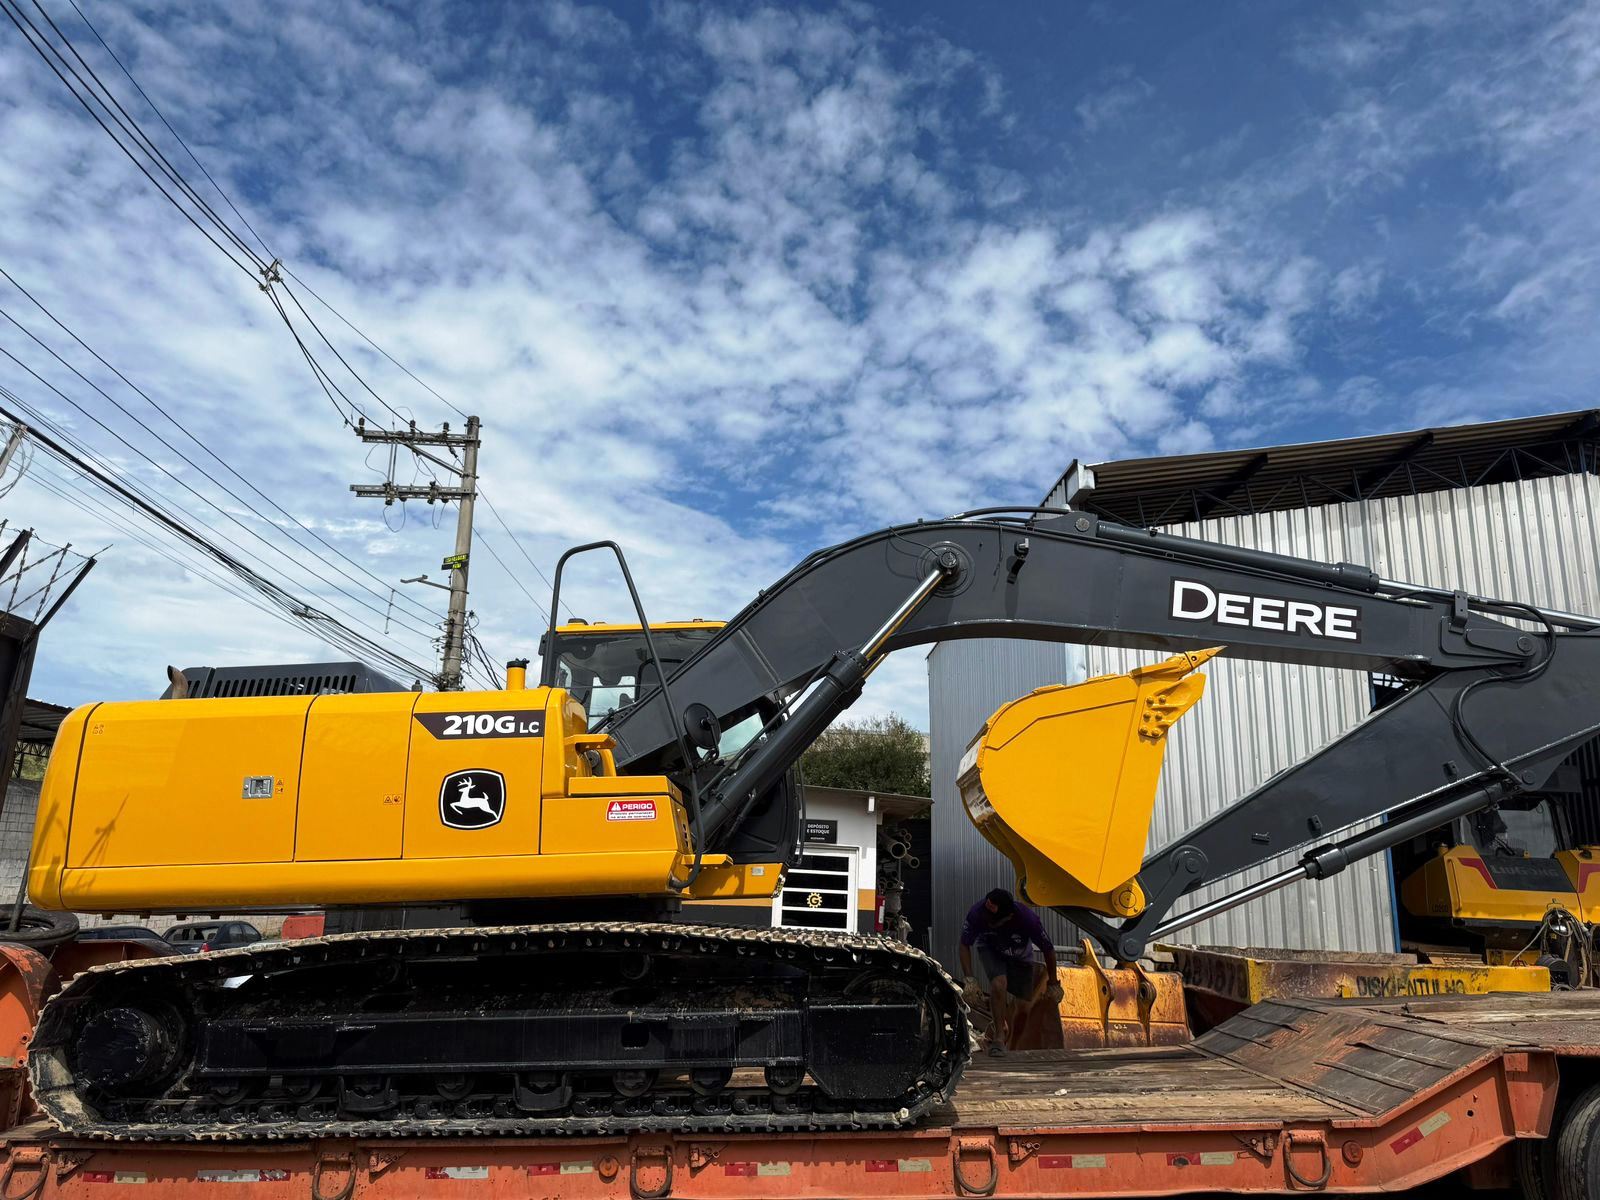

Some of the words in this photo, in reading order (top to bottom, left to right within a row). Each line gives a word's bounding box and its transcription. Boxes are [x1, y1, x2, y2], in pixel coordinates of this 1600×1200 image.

[1172, 580, 1358, 640] DEERE
[443, 714, 516, 735] 210G
[519, 721, 540, 734] LC
